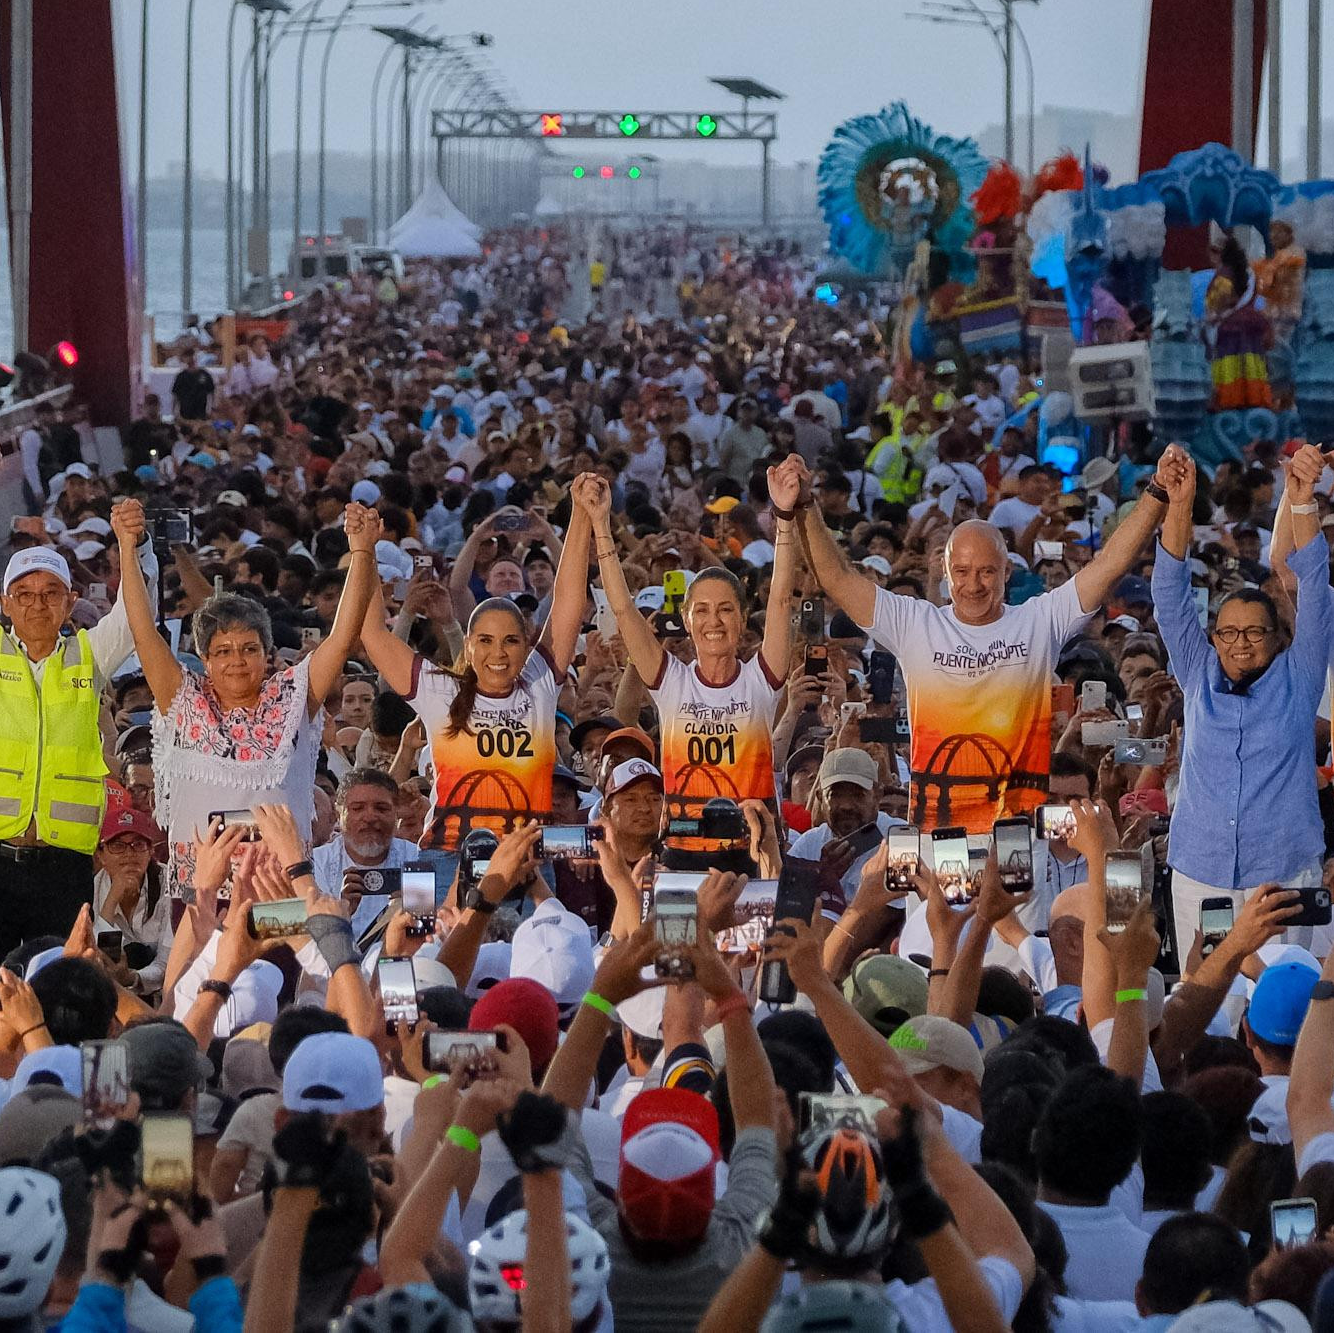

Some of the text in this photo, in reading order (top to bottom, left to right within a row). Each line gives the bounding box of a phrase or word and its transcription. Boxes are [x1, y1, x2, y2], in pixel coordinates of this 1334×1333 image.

[933, 651, 976, 669] PUENTE
[684, 722, 739, 736] CLAUDIA
[477, 728, 534, 758] 002
[687, 735, 735, 765] 001
